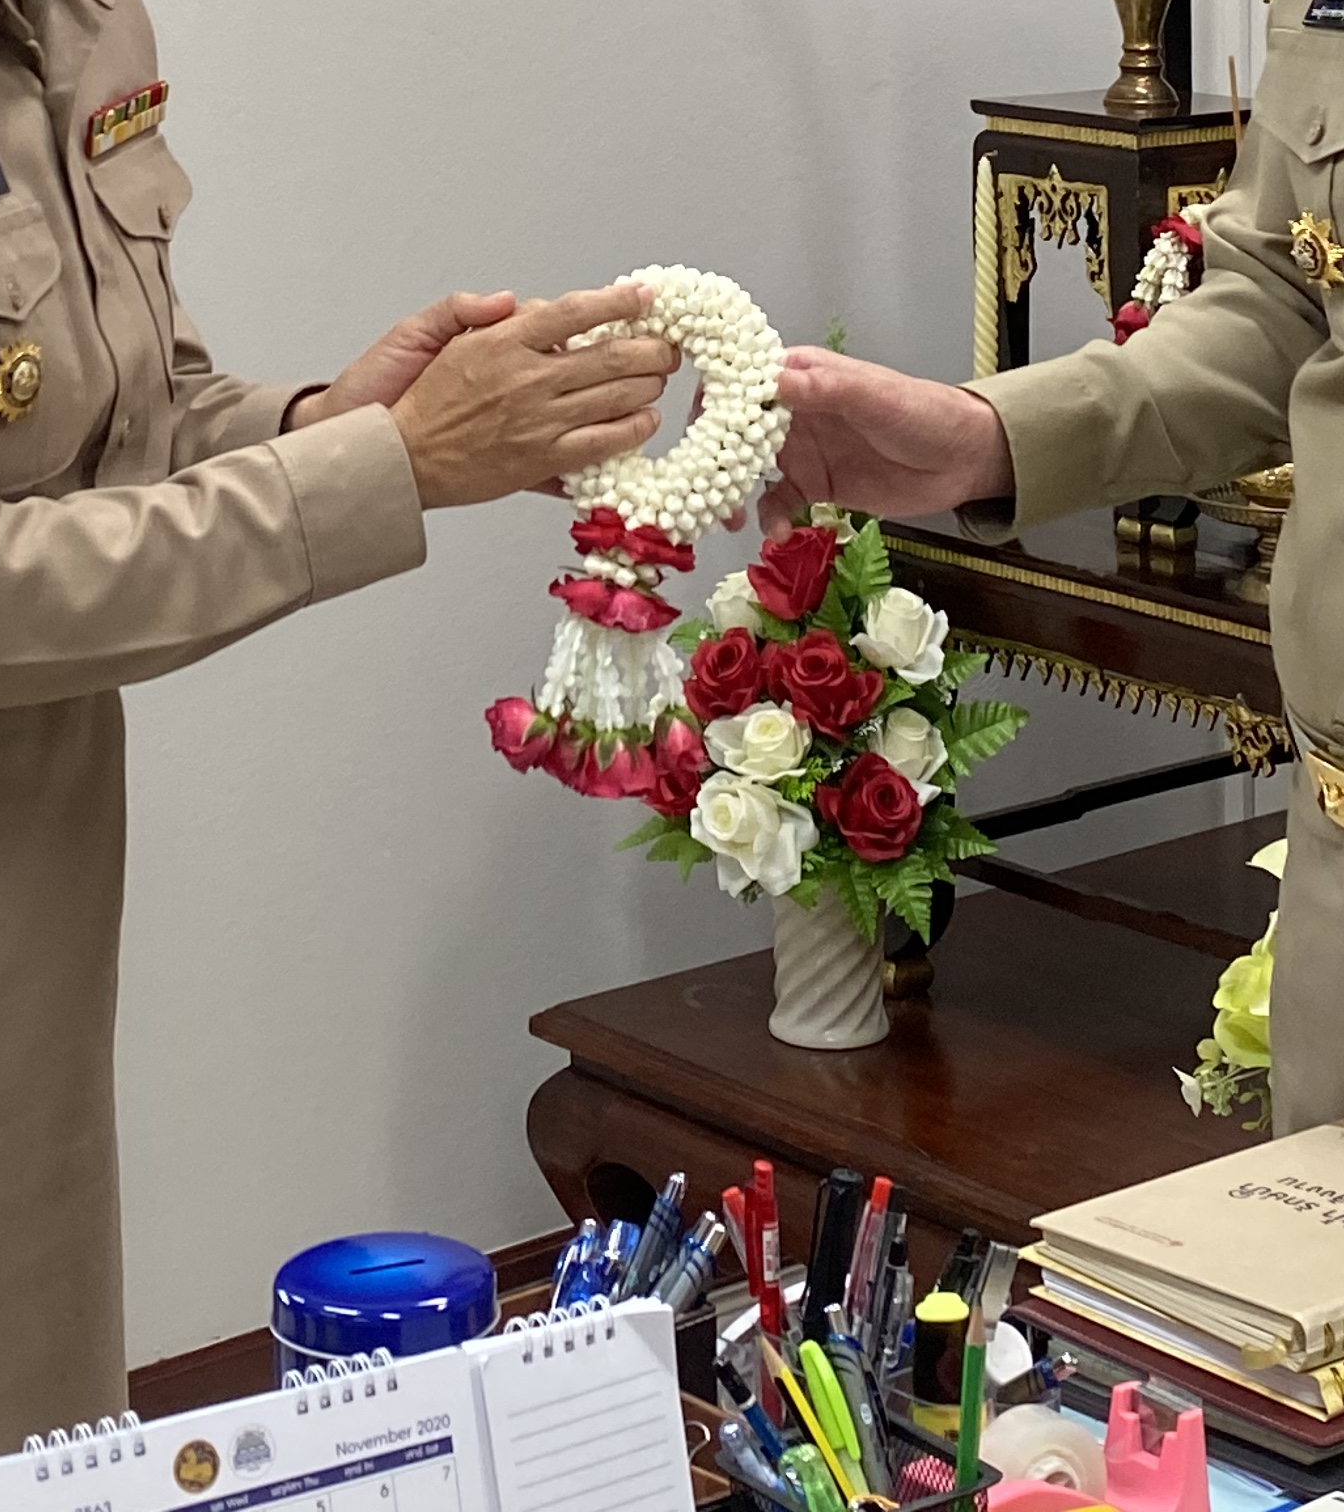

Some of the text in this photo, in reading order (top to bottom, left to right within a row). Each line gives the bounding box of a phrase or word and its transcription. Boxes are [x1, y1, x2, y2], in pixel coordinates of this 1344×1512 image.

[336, 1427, 412, 1458] November
[417, 1413, 451, 1436] 2020
[442, 1465, 451, 1482] 7
[380, 1483, 390, 1499] 6
